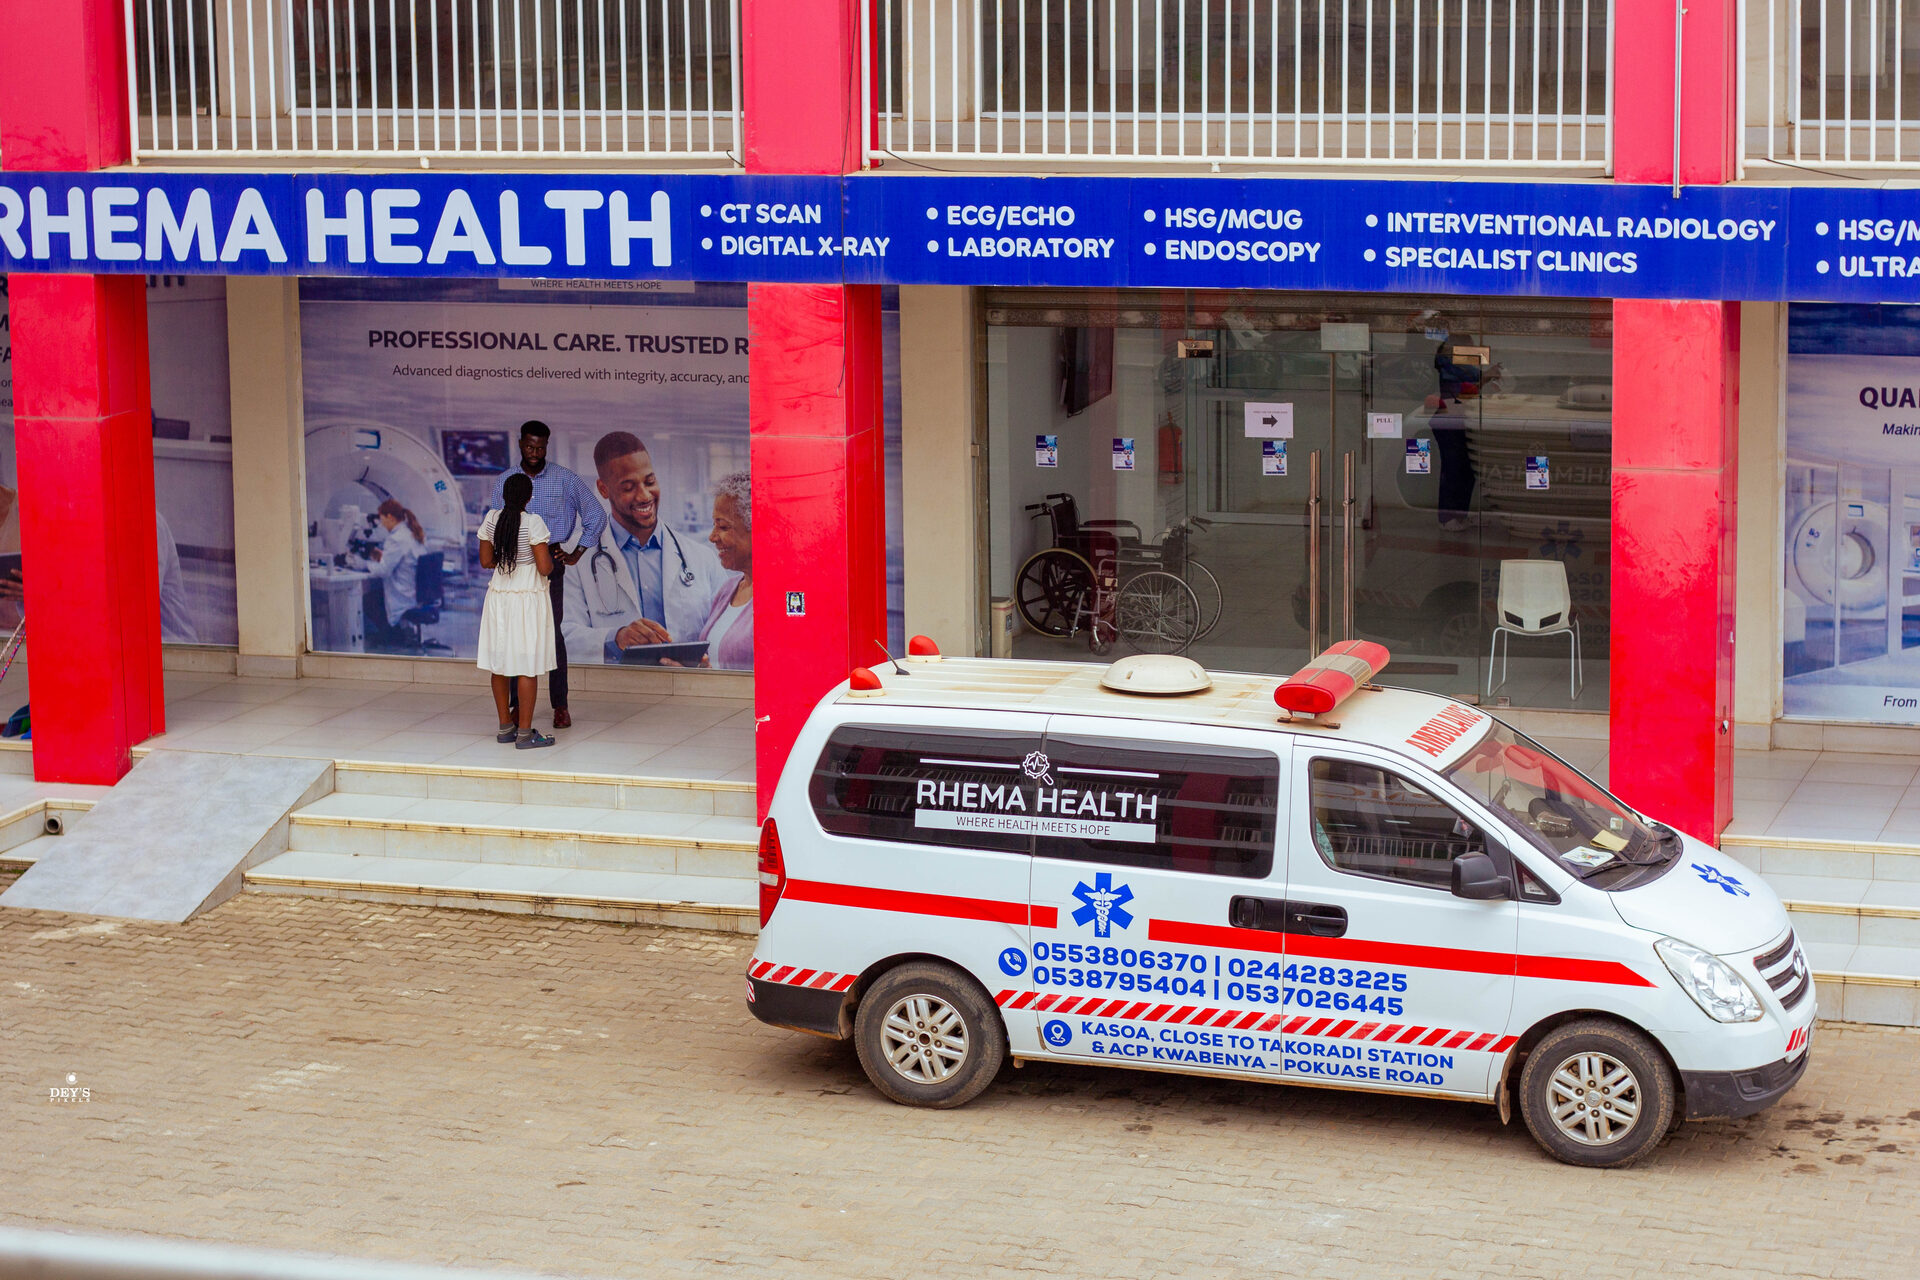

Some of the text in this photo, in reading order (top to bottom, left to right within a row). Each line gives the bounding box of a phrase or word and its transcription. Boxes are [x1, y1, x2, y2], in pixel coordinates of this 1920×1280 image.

[720, 203, 821, 224] CT SCAN
[947, 205, 1075, 231] ECG/ECHO
[1165, 207, 1303, 234] HSG/MCUG
[1387, 212, 1776, 241] INTERVENTIONAL RADIOLOGY
[305, 188, 671, 267] HEALTH
[721, 235, 890, 256] DIGITAL X-RAY
[948, 237, 1115, 258] LABORATORY
[1165, 240, 1321, 262] ENDOSCOPY
[1385, 246, 1638, 274] SPECIALIST CLINICS
[531, 280, 662, 290] WHERE HEALTH MEETS HOPE
[368, 330, 548, 351] PROFESSIONAL
[553, 332, 621, 352] CARE.
[625, 334, 729, 355] TRUSTED
[392, 364, 452, 376] Advanced
[455, 365, 524, 380] diagnostics
[526, 366, 581, 380] delivered
[584, 368, 611, 380] with
[614, 369, 668, 384] integrity,
[670, 372, 726, 386] accuracy,
[1883, 695, 1918, 708] From
[1404, 703, 1485, 758] AMBULANCE
[916, 779, 1157, 820] RHEMA HEALTH
[956, 815, 1111, 836] WHERE HEALTH MEETS HOPE
[1033, 941, 1207, 974] 0553806370
[1228, 957, 1408, 992] 0244283225
[1033, 966, 1206, 998] 0538795404
[1227, 982, 1404, 1016] 0537026445
[1081, 1021, 1454, 1069] KASOA, CLOSE TO TAKORADI STATION
[1092, 1041, 1105, 1054] &
[1109, 1042, 1149, 1057] ACP
[1153, 1046, 1267, 1069] KWABENYA
[1284, 1058, 1380, 1080] POKUASE
[1386, 1068, 1444, 1086] ROAD
